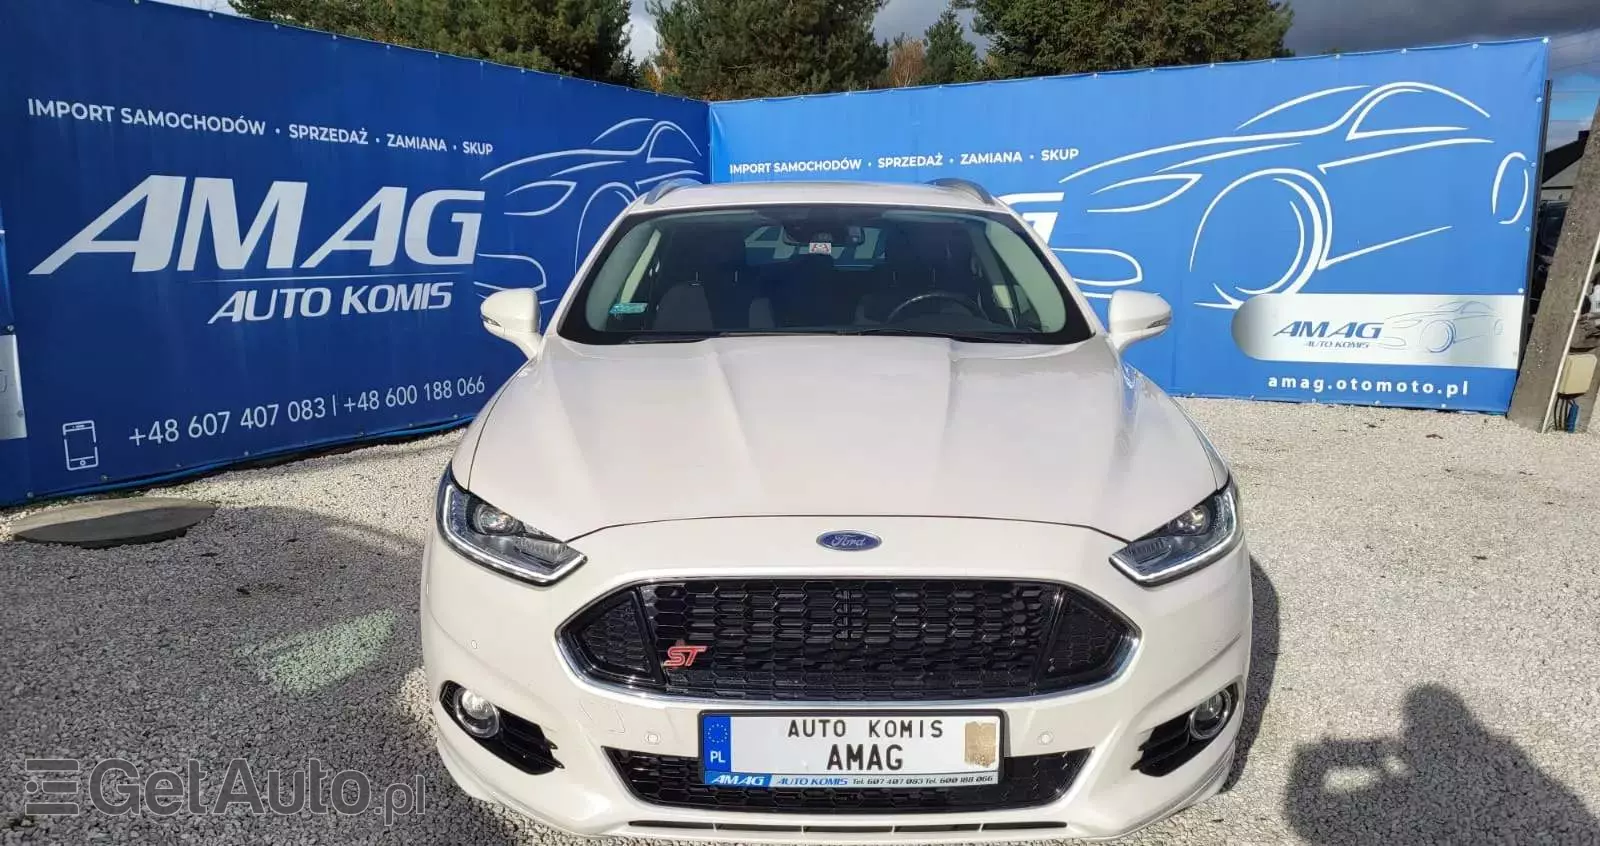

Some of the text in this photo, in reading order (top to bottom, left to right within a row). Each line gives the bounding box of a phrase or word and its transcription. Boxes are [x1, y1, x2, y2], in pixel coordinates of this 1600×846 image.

[28, 98, 493, 155] IMPORT SAMOCHODÓW SPRZEDAŻ ZAMIANA SKUP
[729, 148, 1080, 175] IMPORT SAMOCHODÓW SPRZEDAŻ ZAMIANA SKUP
[207, 281, 454, 324] AUTO KOMIS
[1267, 374, 1469, 398] amag.otomoto.pl
[128, 375, 486, 447] +48 607 407 083 +48 600 188 066
[831, 534, 867, 547] Ford
[664, 645, 707, 667] ST
[788, 719, 944, 738] AUTO KOMIS
[709, 751, 726, 763] PL
[826, 744, 904, 771] AMAG
[777, 777, 808, 786] AUTO
[810, 777, 848, 786] KOMIS
